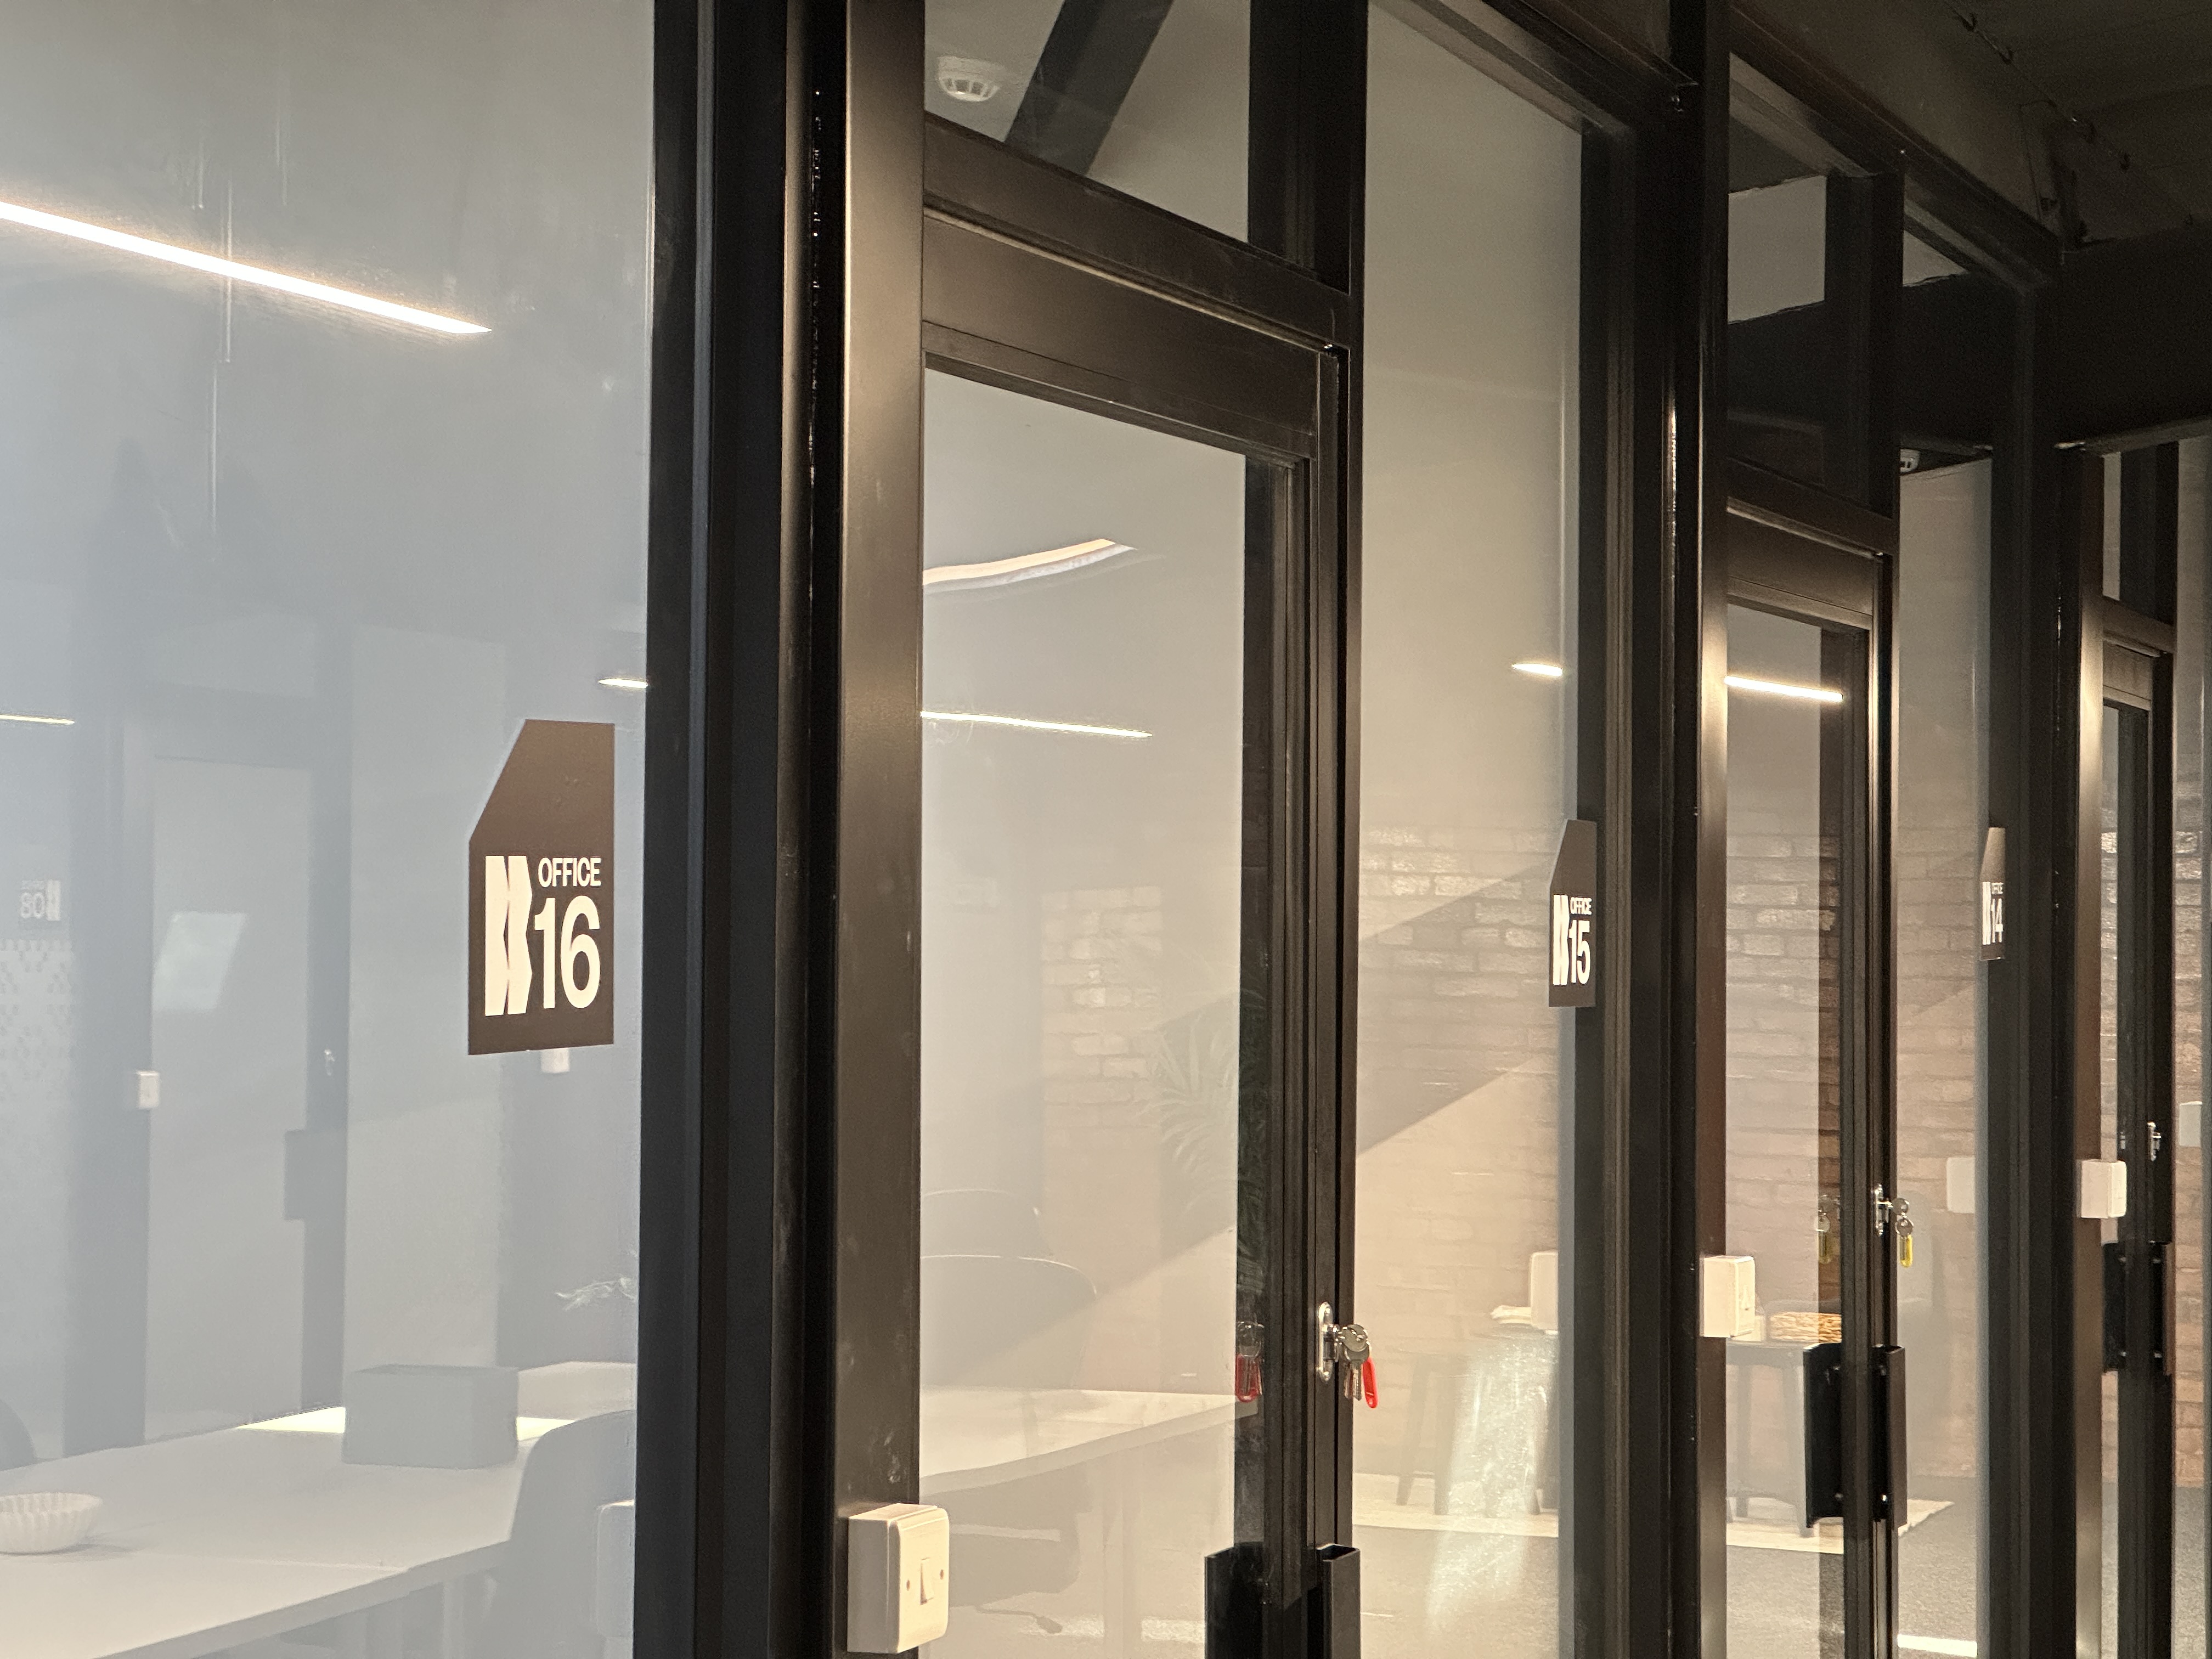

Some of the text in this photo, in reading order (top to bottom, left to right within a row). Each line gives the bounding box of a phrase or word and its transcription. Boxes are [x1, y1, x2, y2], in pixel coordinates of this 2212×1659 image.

[538, 857, 601, 887] OFFICE
[1570, 897, 1592, 915] OFFICE
[1991, 898, 2003, 943] 14
[534, 895, 601, 1009] 16
[1569, 919, 1590, 984] 15
